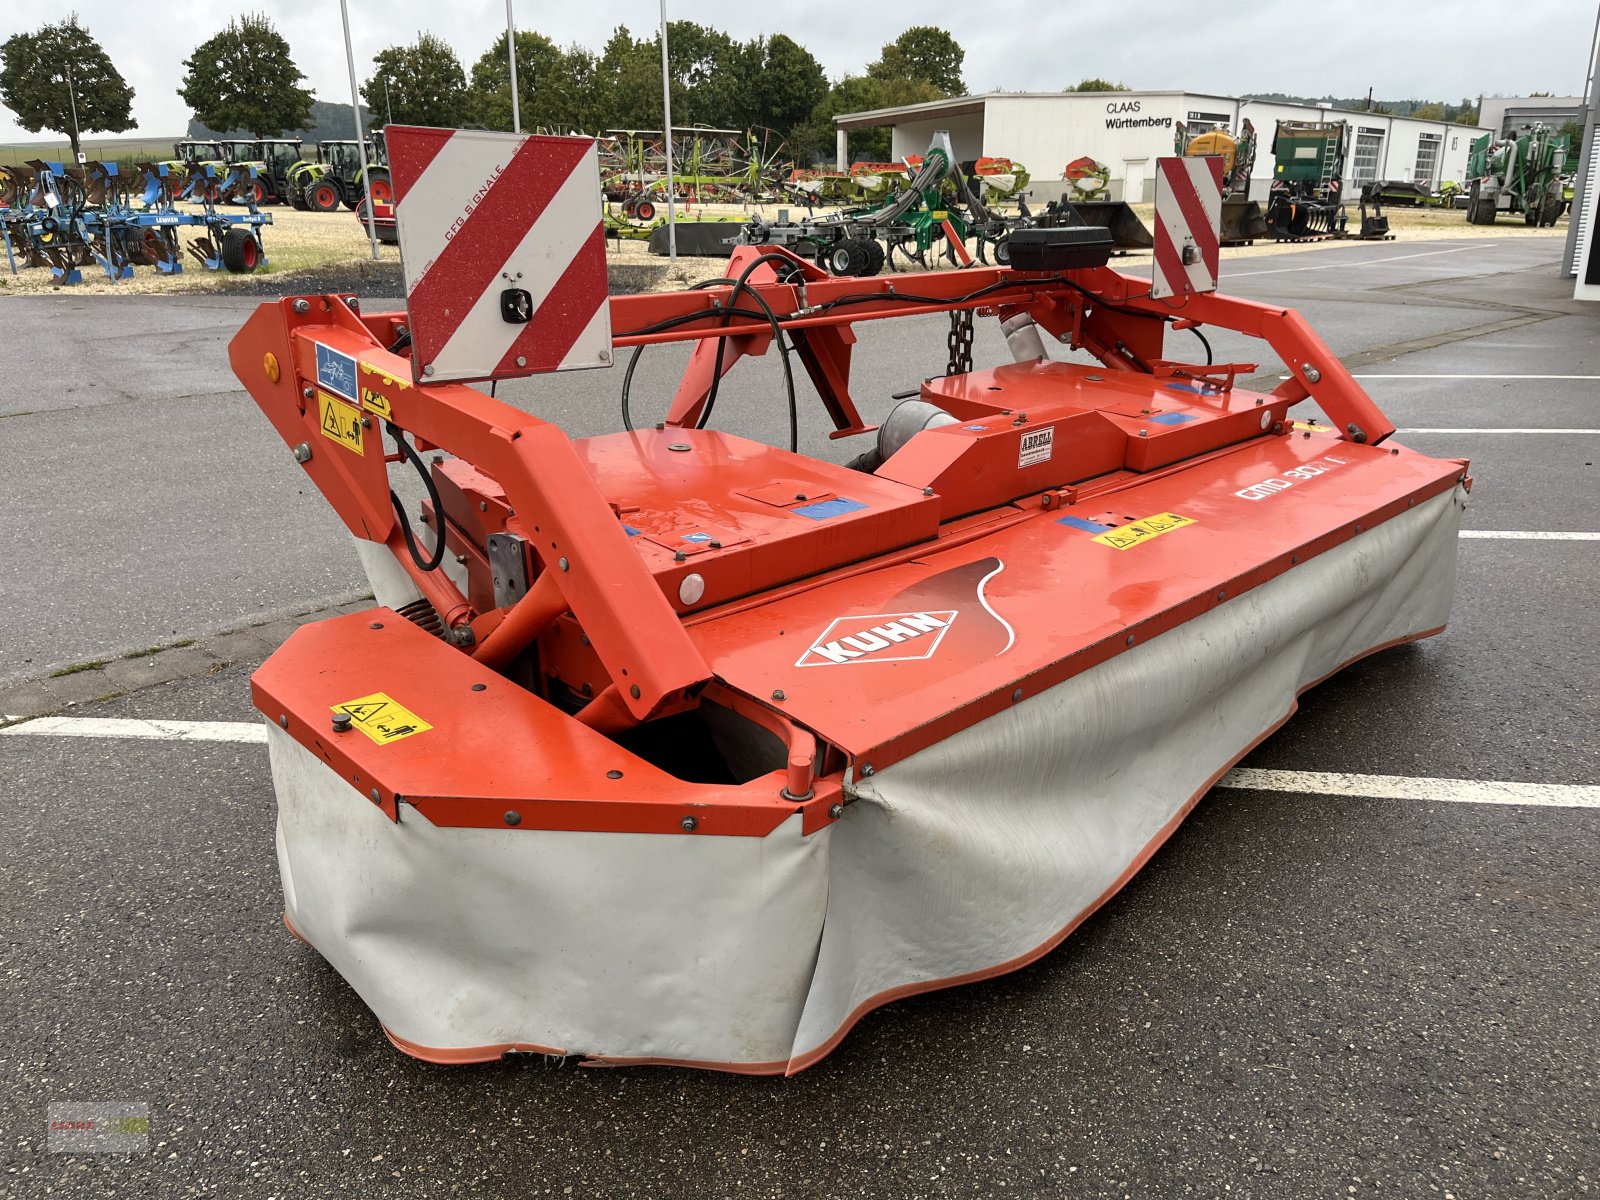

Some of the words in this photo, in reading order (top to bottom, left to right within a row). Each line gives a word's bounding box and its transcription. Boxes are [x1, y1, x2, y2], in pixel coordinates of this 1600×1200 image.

[1106, 100, 1141, 114] CLAAS
[1105, 116, 1172, 130] Württemberg
[444, 216, 465, 241] CFG
[1021, 431, 1052, 451] ABRELL
[1234, 478, 1294, 501] GMD
[808, 612, 949, 664] KUHN
